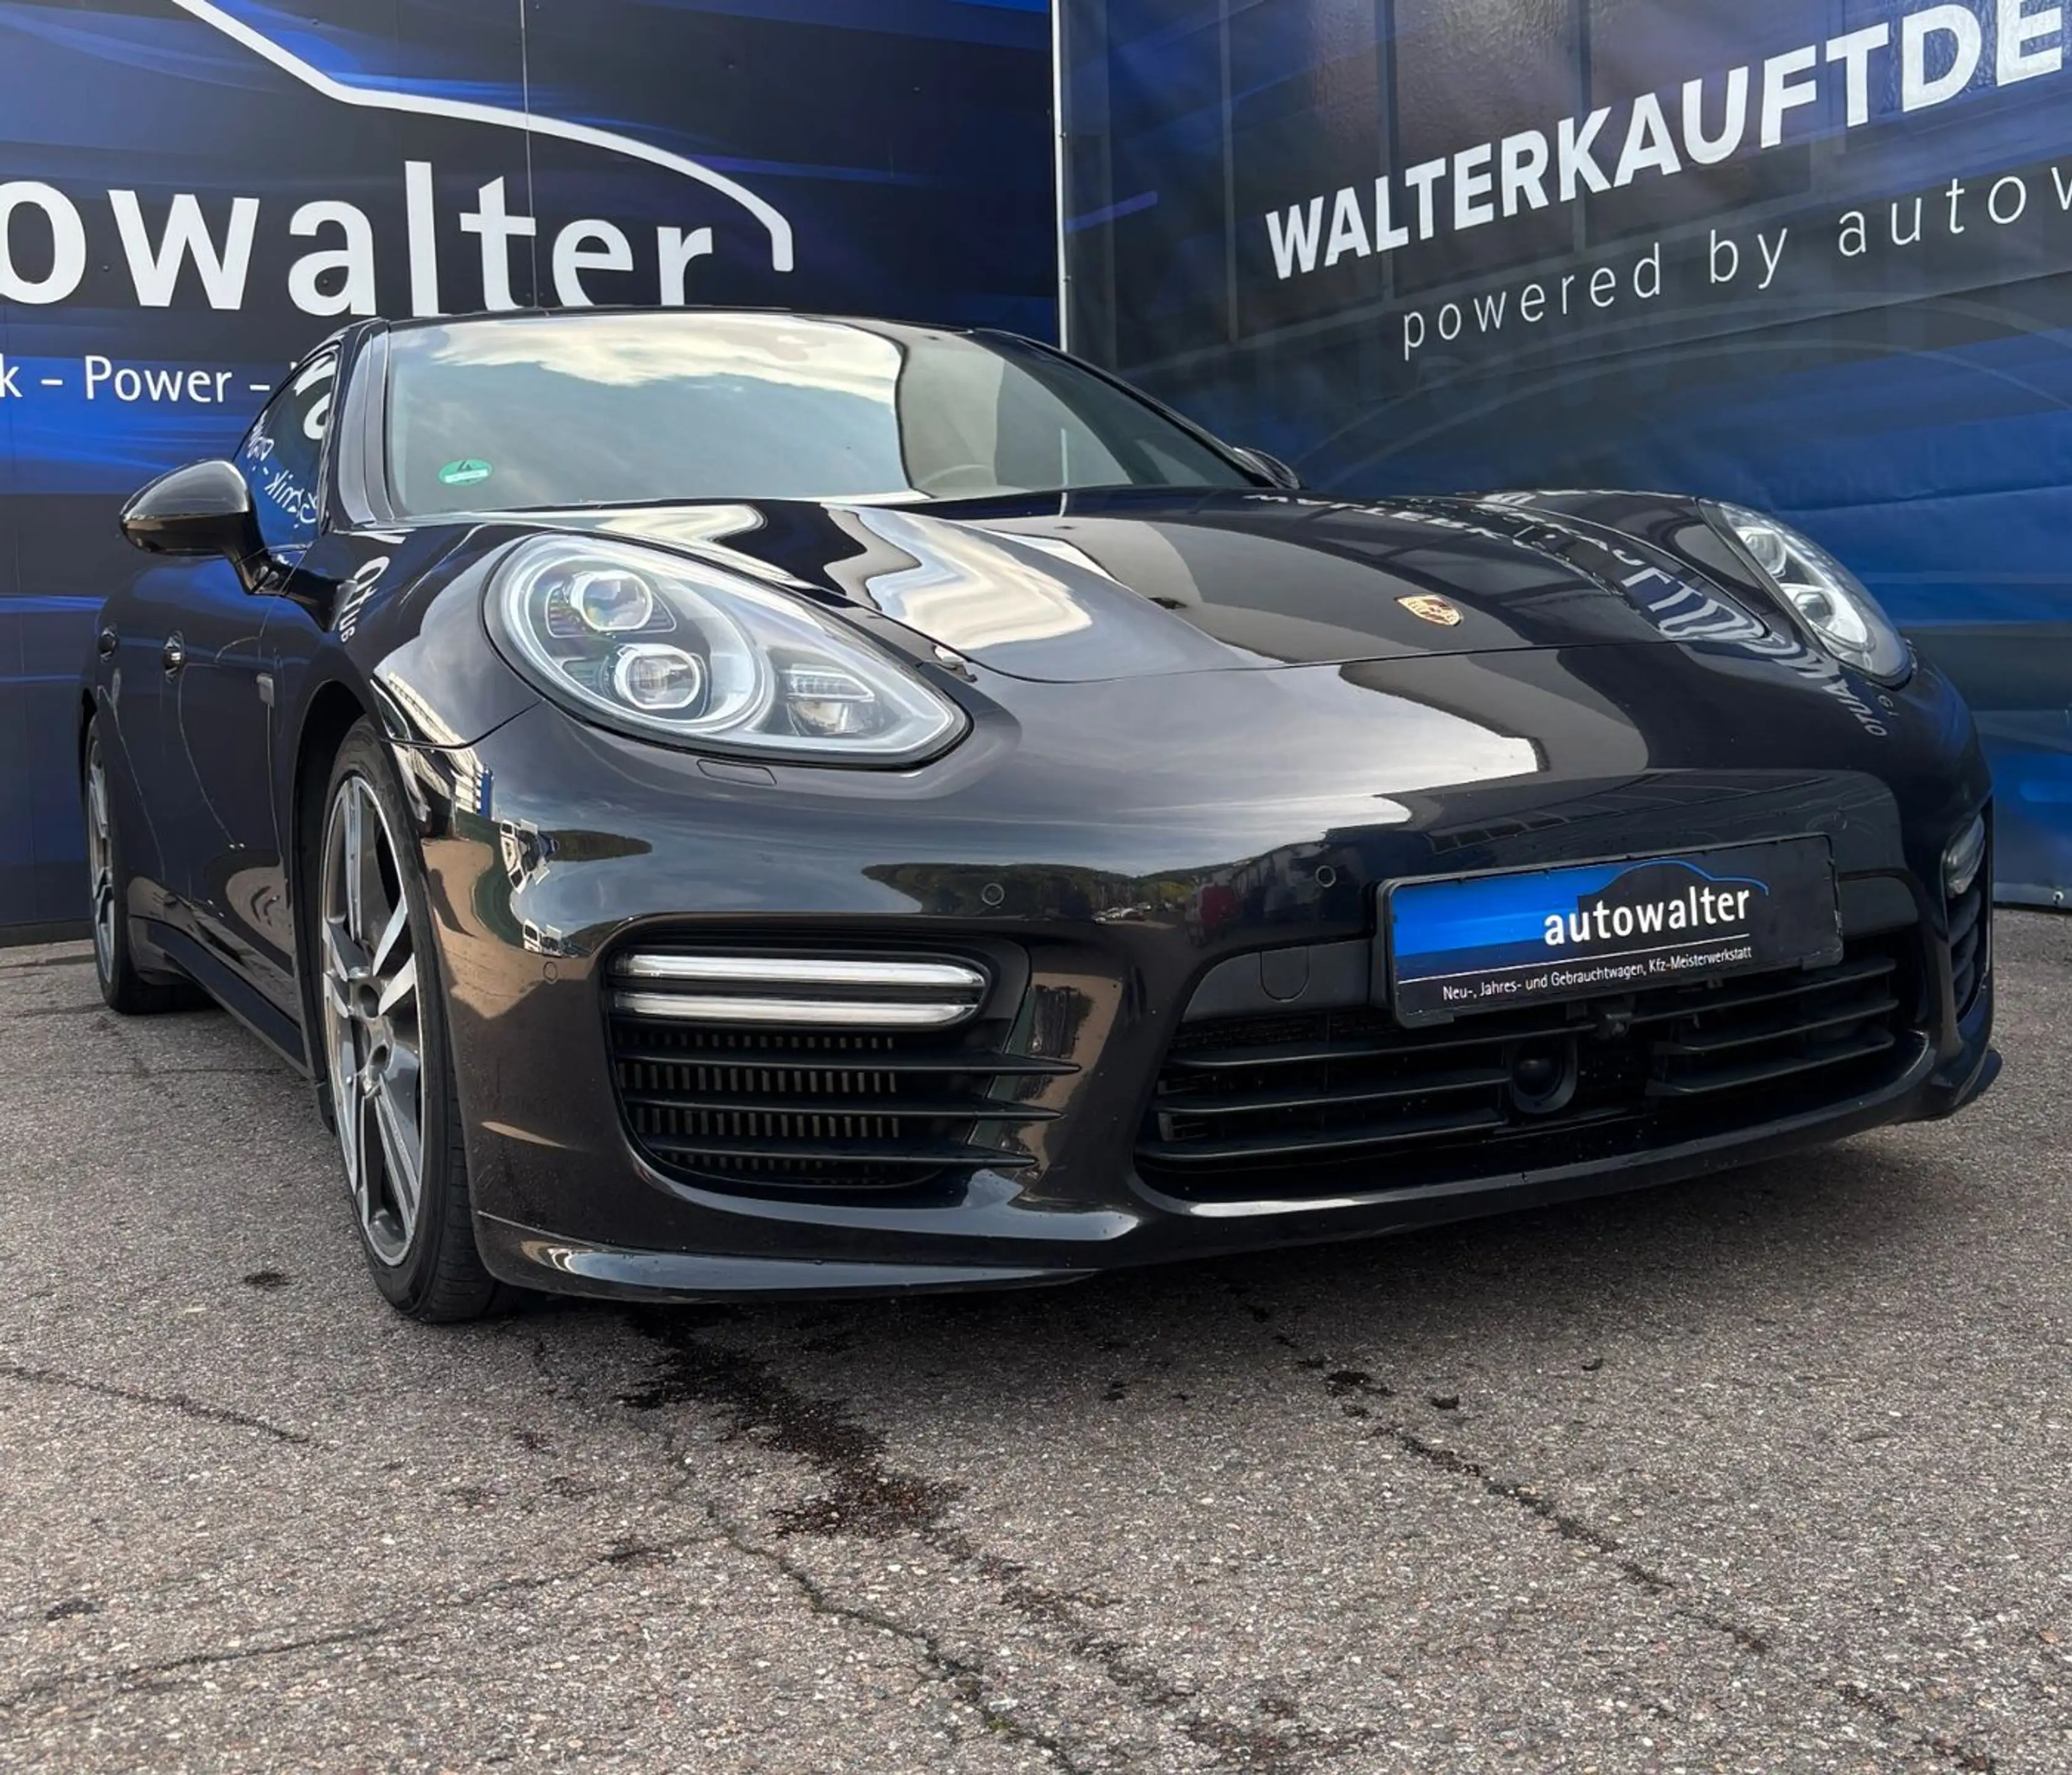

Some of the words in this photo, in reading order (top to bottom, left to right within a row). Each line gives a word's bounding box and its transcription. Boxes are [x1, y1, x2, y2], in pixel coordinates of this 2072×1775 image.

[1265, 0, 2062, 280] WALTERKAUFTDE
[0, 160, 713, 317] owalter
[1402, 242, 1661, 361] powered
[1709, 227, 1787, 289] by
[85, 355, 232, 402] Power
[1544, 886, 1749, 946] autowalter
[1443, 986, 1477, 1001] Neu-,
[1479, 981, 1522, 997] Jahres-
[1525, 974, 1548, 990] und
[1551, 963, 1647, 986] Gebrauchtwagen,
[1649, 946, 1752, 973] Kfz-Meisterwerkstatt
